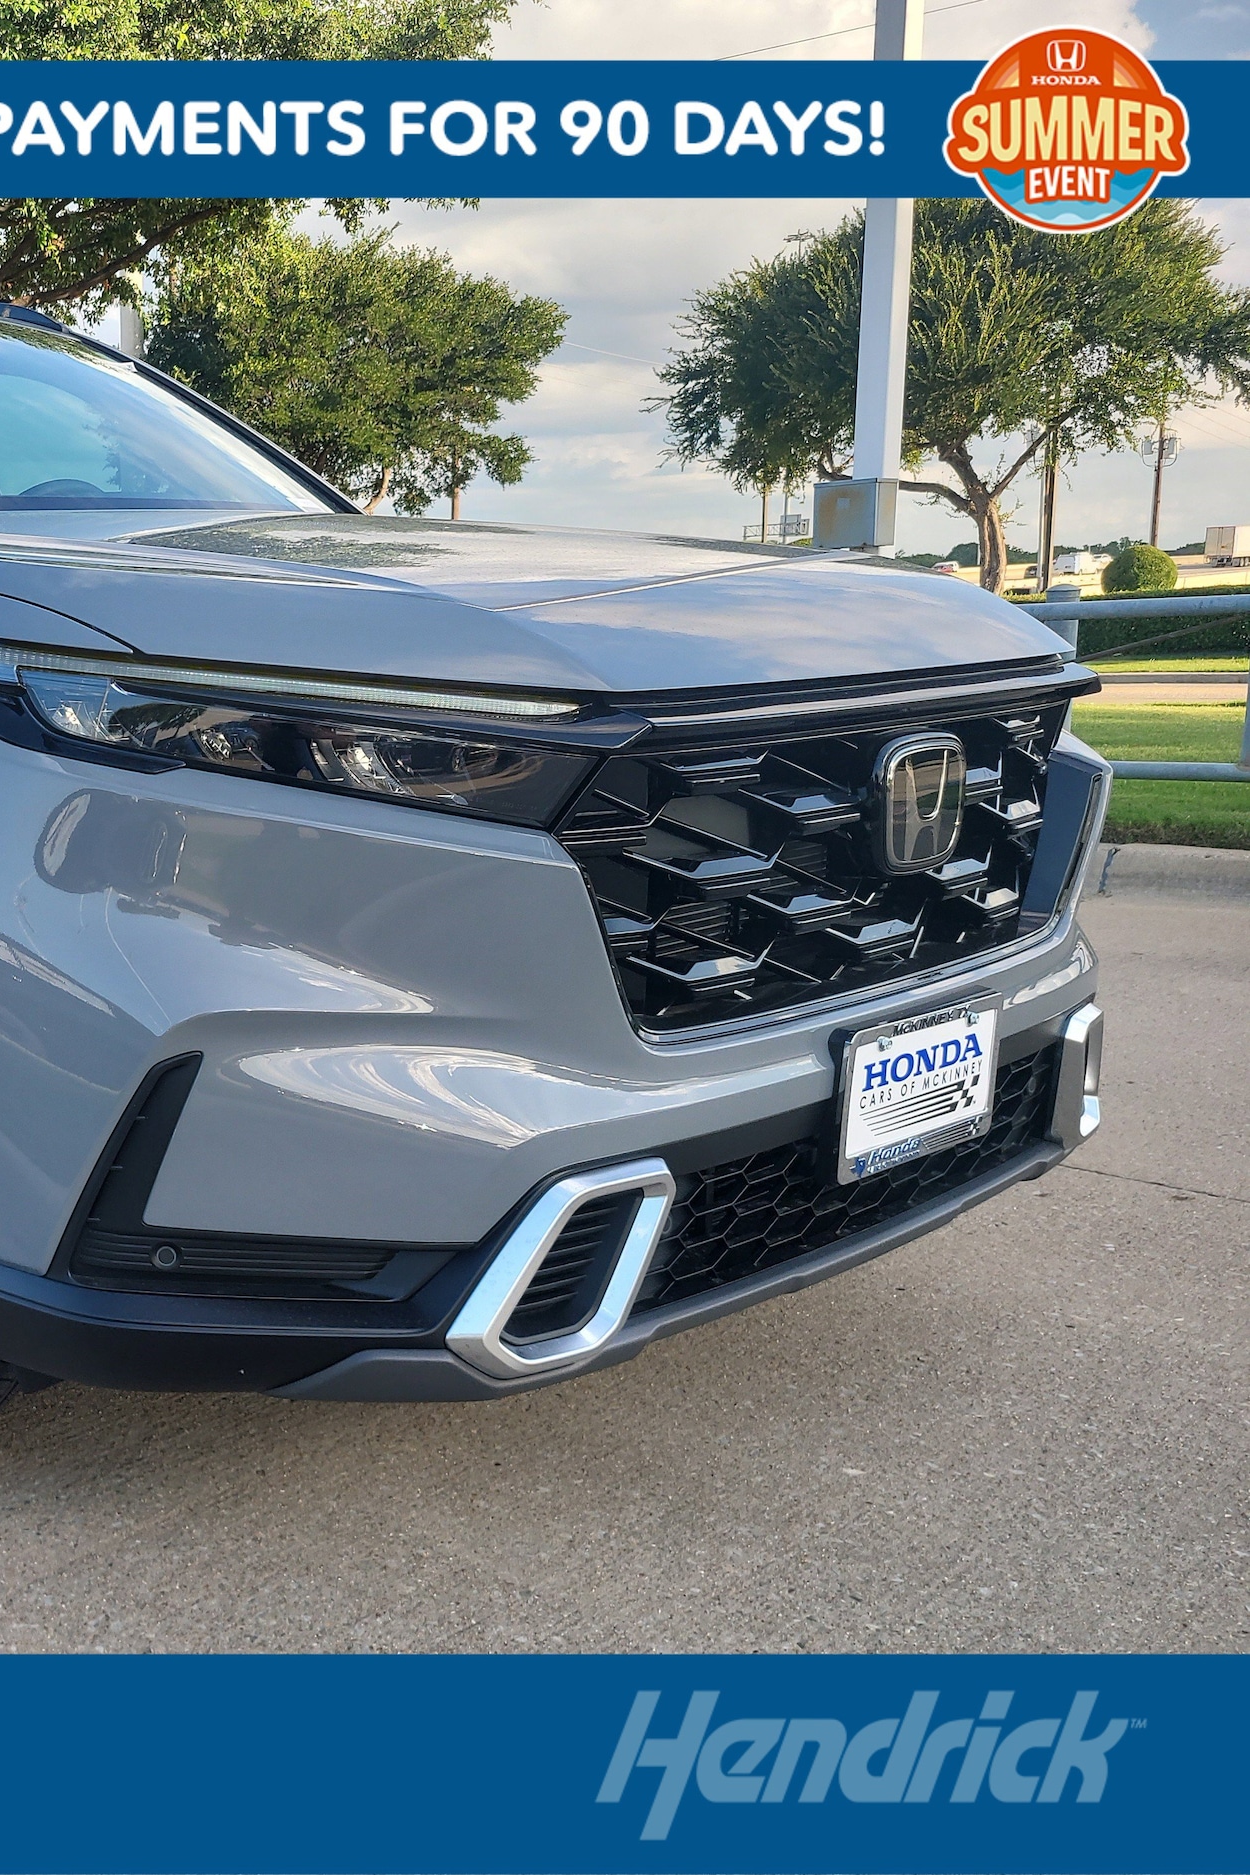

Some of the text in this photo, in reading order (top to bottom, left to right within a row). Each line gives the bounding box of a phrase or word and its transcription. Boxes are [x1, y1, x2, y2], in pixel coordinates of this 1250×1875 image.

[859, 1059, 983, 1109] CARS OF MCKINNEY
[862, 1033, 983, 1093] HONDA
